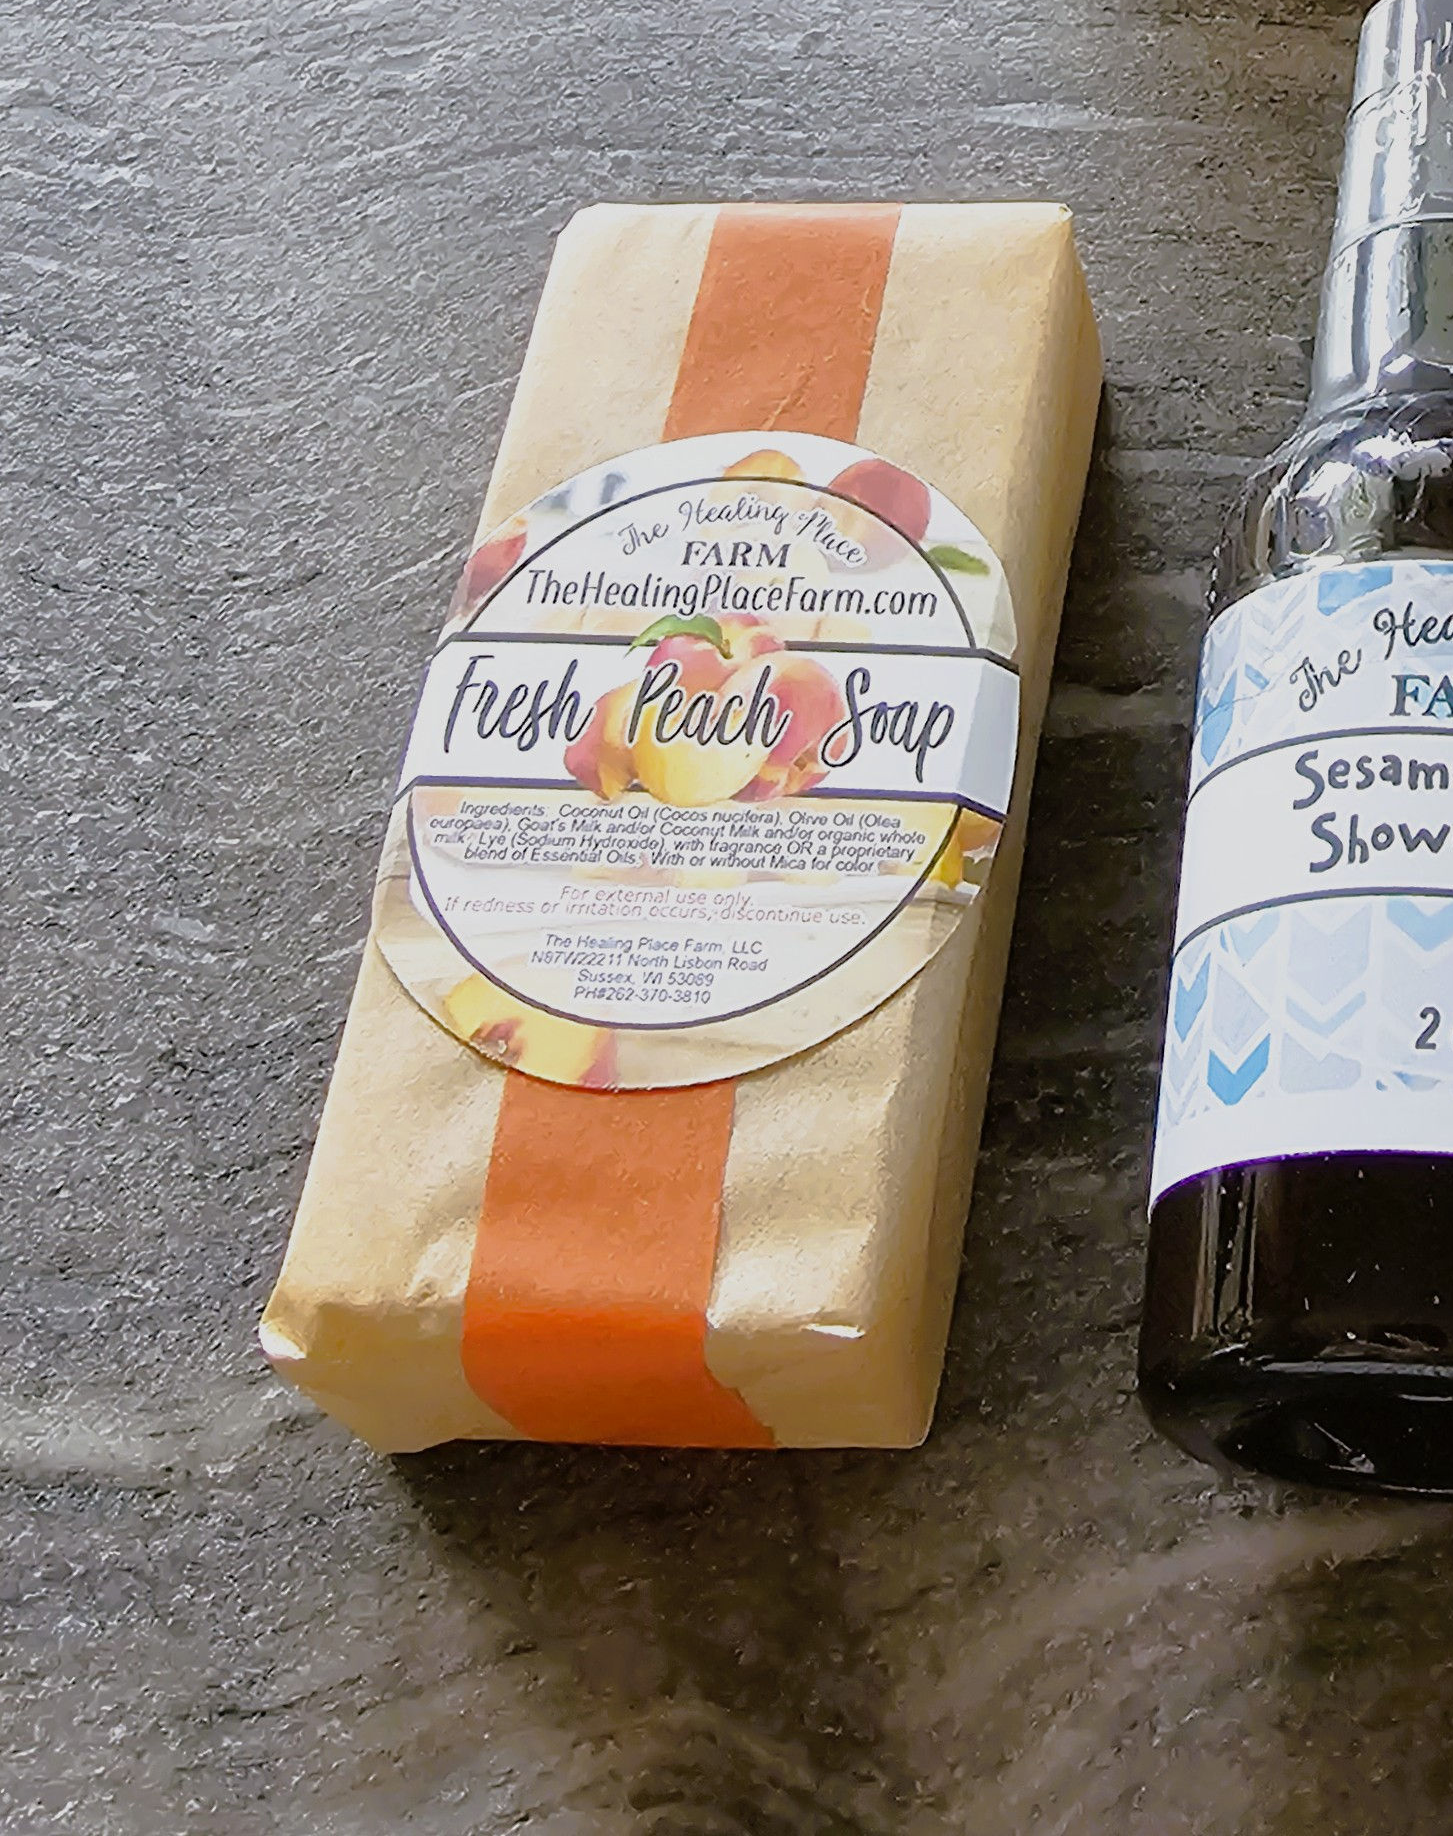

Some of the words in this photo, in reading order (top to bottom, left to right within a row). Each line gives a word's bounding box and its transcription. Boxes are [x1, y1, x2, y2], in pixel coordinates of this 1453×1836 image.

[619, 518, 671, 556] The
[678, 496, 790, 536] Healing
[796, 507, 868, 566] Place
[682, 540, 791, 569] FARM
[526, 570, 938, 618] TheHealingPlaceFarm.com
[1288, 647, 1362, 712] The
[444, 654, 597, 755] Fresh
[627, 662, 791, 747] Peach
[822, 667, 956, 782] Soap
[560, 804, 624, 819] Coconut
[628, 806, 649, 820] Oil
[653, 806, 707, 823] (Cocos
[833, 813, 854, 827] Oil
[859, 813, 901, 830] (Olea
[606, 820, 656, 835] and/or
[661, 822, 725, 837] Coconut
[765, 825, 813, 841] and/or
[818, 828, 875, 845] organic
[880, 830, 926, 845] whole
[464, 844, 507, 861] blend
[512, 848, 528, 862] of
[530, 850, 602, 863] Essential
[651, 852, 685, 866] With
[689, 855, 706, 867] or
[710, 855, 766, 870] without
[770, 856, 806, 871] Mica
[811, 858, 832, 872] for
[479, 832, 505, 848] Lye
[674, 839, 704, 852] with
[709, 840, 783, 856] fragrance
[787, 841, 811, 855] OR
[817, 845, 827, 856] a
[831, 844, 916, 862] proprietary
[560, 885, 590, 900] For
[595, 889, 670, 904] external
[676, 892, 707, 905] use
[463, 897, 535, 913] redness
[541, 901, 559, 914] or
[566, 902, 642, 917] irritation
[721, 905, 822, 923] discontinue
[546, 933, 572, 949] The
[577, 934, 633, 953] Healing
[637, 937, 679, 953] Place
[732, 940, 763, 955] LLC
[627, 954, 669, 968] North
[673, 954, 723, 970] Lisbon
[727, 957, 769, 972] Road
[643, 971, 663, 985] WI
[1414, 1005, 1438, 1052] 2
